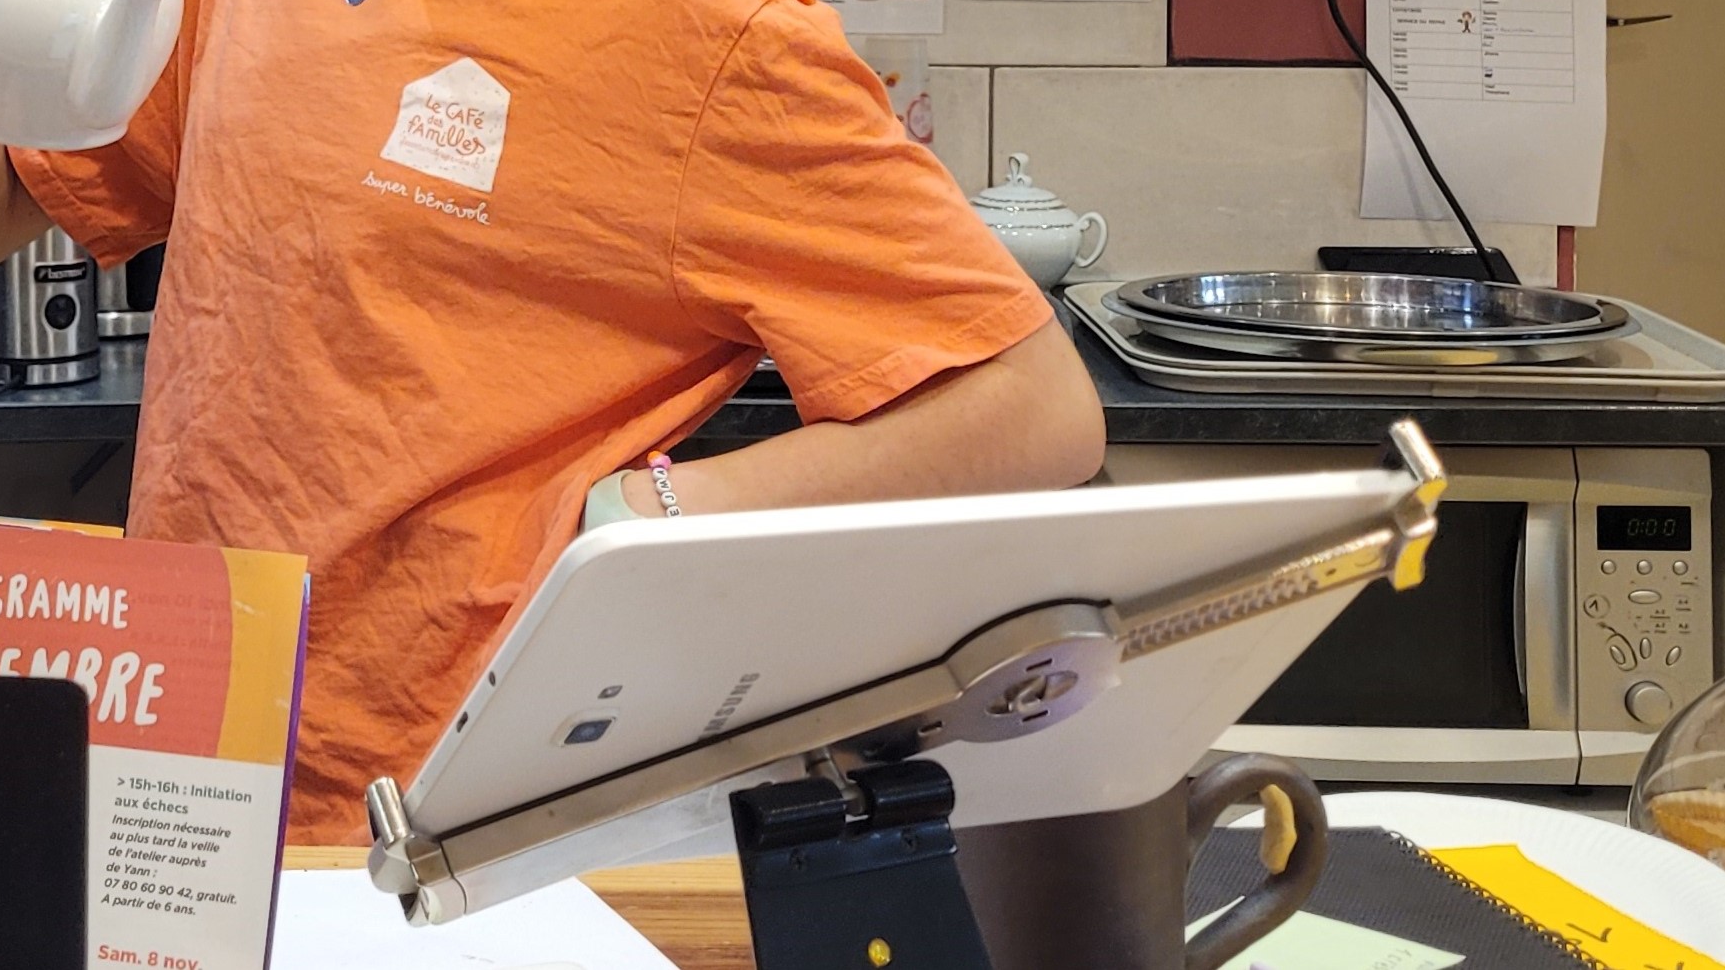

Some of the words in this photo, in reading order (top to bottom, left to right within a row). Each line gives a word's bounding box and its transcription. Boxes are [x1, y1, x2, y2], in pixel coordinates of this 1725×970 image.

[425, 94, 441, 114] Le
[361, 170, 408, 197] super
[414, 186, 491, 225] bénévole
[129, 777, 179, 795] 15h-16h
[191, 785, 253, 804] Initiation
[114, 796, 139, 809] aux
[142, 797, 189, 815] échecs
[112, 814, 171, 831] Inscription
[173, 822, 232, 839] nécessaire
[109, 831, 124, 841] au
[125, 832, 150, 846] plus
[152, 835, 177, 848] tard
[177, 837, 188, 850] la
[190, 839, 221, 854] veille
[108, 846, 123, 857] de
[168, 854, 207, 868] auprès
[106, 861, 121, 873] de
[124, 864, 151, 877] Yann
[104, 877, 120, 888] 07
[121, 880, 138, 891] 80
[140, 882, 156, 894] 60
[158, 885, 174, 896] 90
[176, 887, 194, 901] 42,
[196, 890, 238, 905] gratuit.
[101, 893, 110, 904] A
[112, 895, 145, 908] partir
[146, 899, 161, 911] de
[164, 901, 172, 912] 6
[173, 905, 196, 916] ans.
[97, 944, 142, 965] Sam.
[147, 951, 159, 967] 8
[163, 954, 203, 970] nov.
